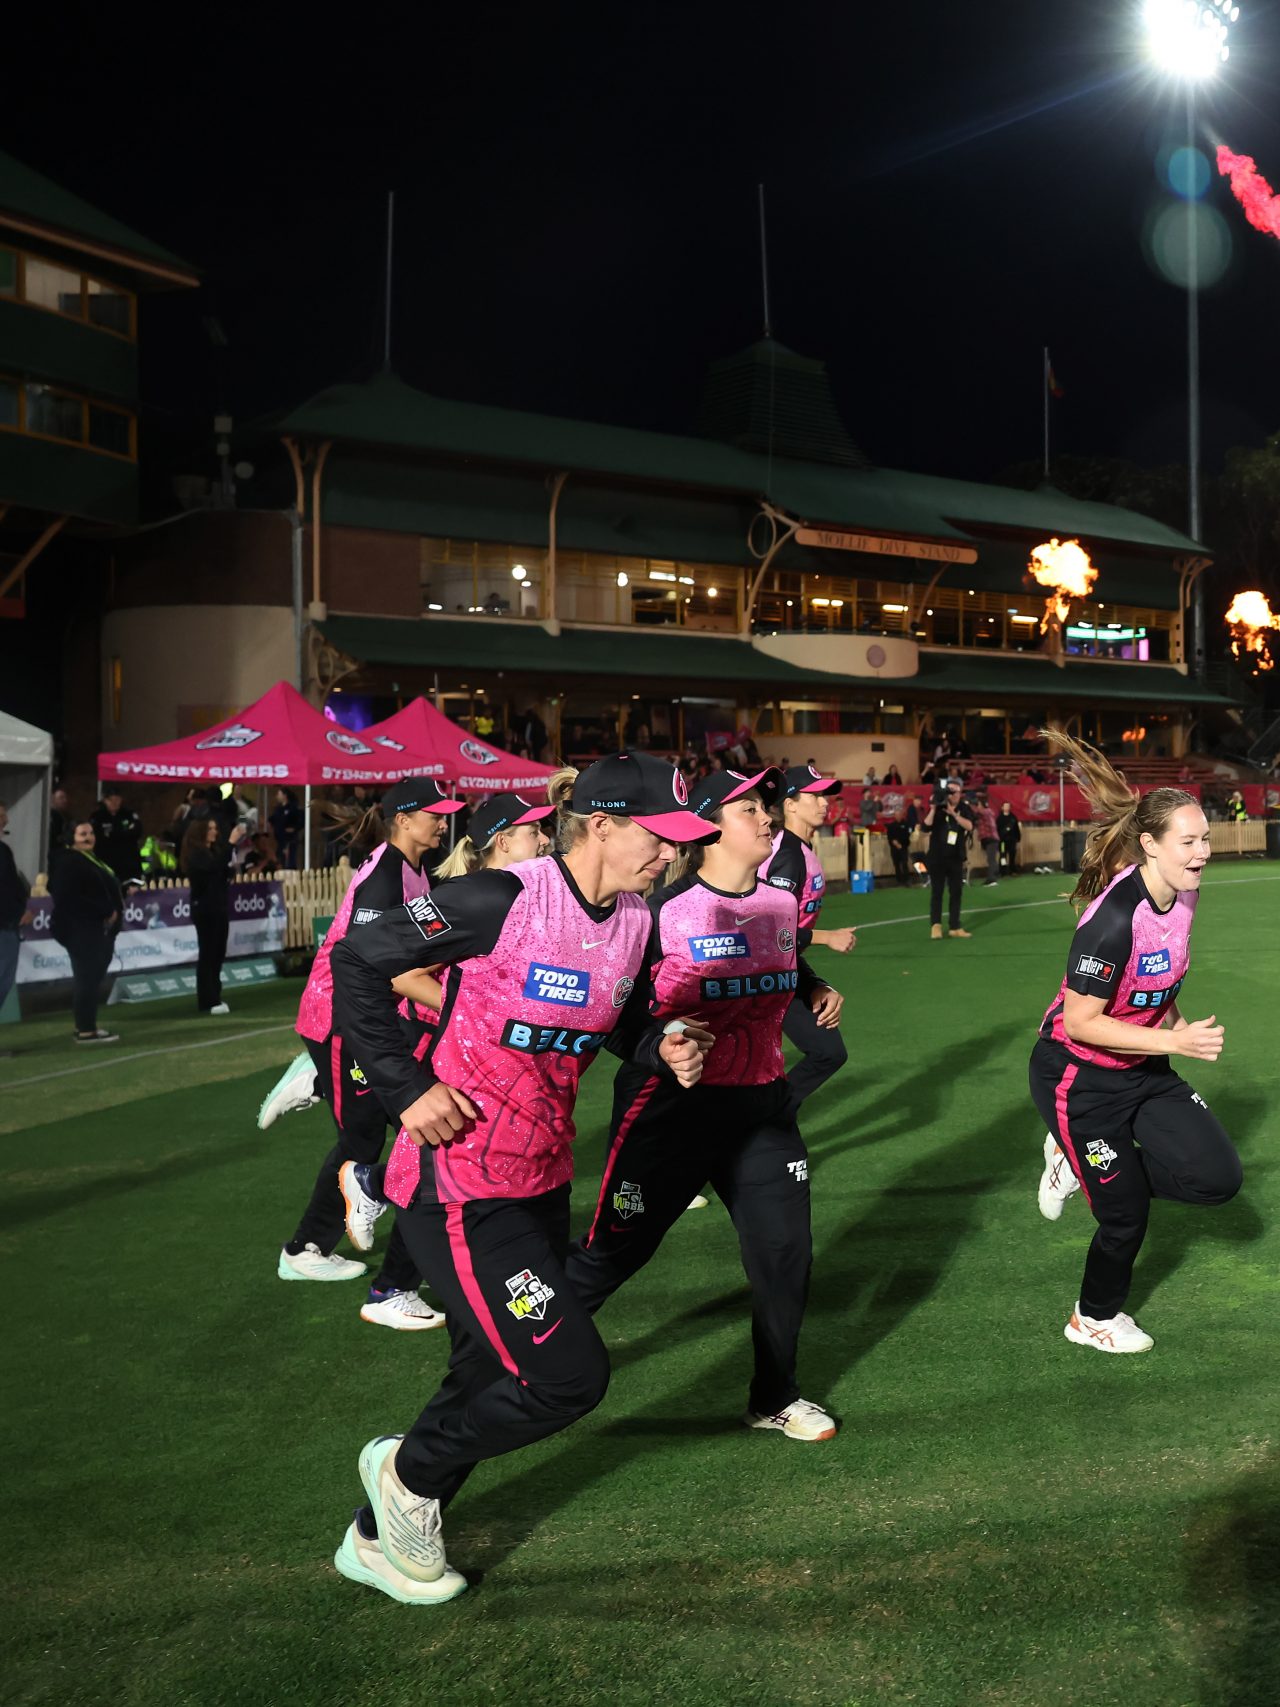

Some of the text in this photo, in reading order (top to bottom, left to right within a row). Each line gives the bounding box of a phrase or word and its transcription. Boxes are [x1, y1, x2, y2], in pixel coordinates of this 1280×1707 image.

[818, 531, 960, 561] MOLLIE DIVE STAND
[116, 762, 288, 778] SYDNEY SIXERS
[322, 766, 383, 780] SYDNEY
[459, 776, 549, 789] SYDNEY SIXER
[234, 894, 265, 913] dodo
[694, 936, 735, 949] TOYO
[703, 945, 746, 958] TIRES
[533, 968, 579, 988] TOYO
[538, 984, 586, 1003] TIRES
[614, 1194, 645, 1212] WBBL
[507, 1285, 555, 1318] WBBL
